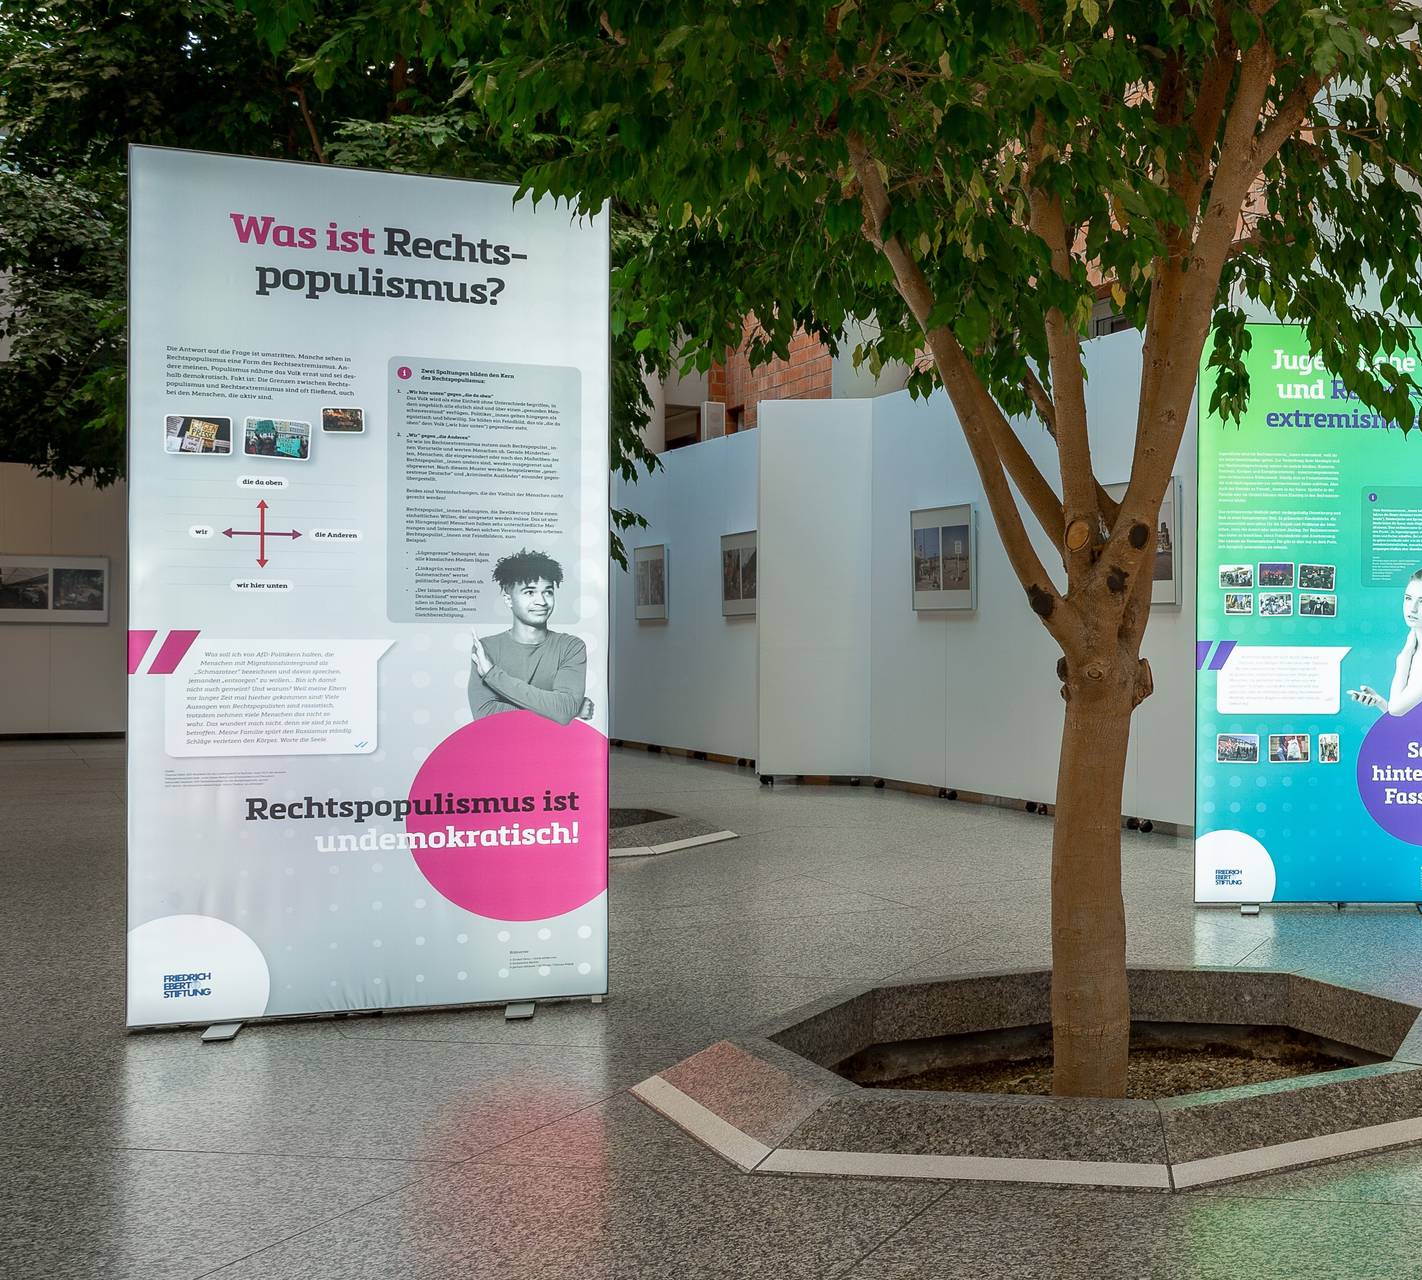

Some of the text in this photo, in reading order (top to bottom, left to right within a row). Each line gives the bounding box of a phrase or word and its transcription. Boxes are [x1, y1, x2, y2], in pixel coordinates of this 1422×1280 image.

[230, 212, 528, 266] Was ist Rechts-
[255, 265, 506, 306] populismus?
[177, 346, 207, 354] Antwort
[206, 347, 219, 355] auf
[231, 349, 251, 358] Frage
[260, 350, 297, 359] umstritten.
[297, 352, 324, 360] Manche
[166, 354, 226, 365] Rechtspopulismus
[272, 359, 336, 369] Rechtsextremismus.
[166, 362, 182, 370] dere
[181, 363, 210, 373] meinen,
[210, 365, 250, 375] Populismus
[286, 368, 301, 376] Volk
[301, 369, 318, 377] ernst
[342, 371, 356, 379] des-
[420, 367, 436, 375] Zwei
[435, 368, 470, 378] Spaltungen
[166, 371, 182, 379] halb
[181, 372, 229, 381] demokratisch.
[229, 374, 245, 382] Fakt
[245, 375, 256, 383] ist:
[268, 376, 296, 384] Grenzen
[296, 378, 327, 386] zwischen
[326, 379, 351, 387] Rechts-
[430, 375, 486, 385] Rechtspopulismus:
[1277, 379, 1325, 399] und
[242, 478, 283, 486] die da oben
[195, 527, 208, 535] wir
[314, 530, 358, 539] die Anderen
[236, 580, 288, 590] wir hier unten
[245, 659, 318, 668] Migrationshintergrund
[245, 790, 579, 823] Rechtspopulismus ist
[315, 822, 579, 853] undemokratisch!
[163, 972, 211, 982] FRIEDRICH
[163, 981, 191, 990] EBERT
[163, 988, 211, 998] STIFTUNG
